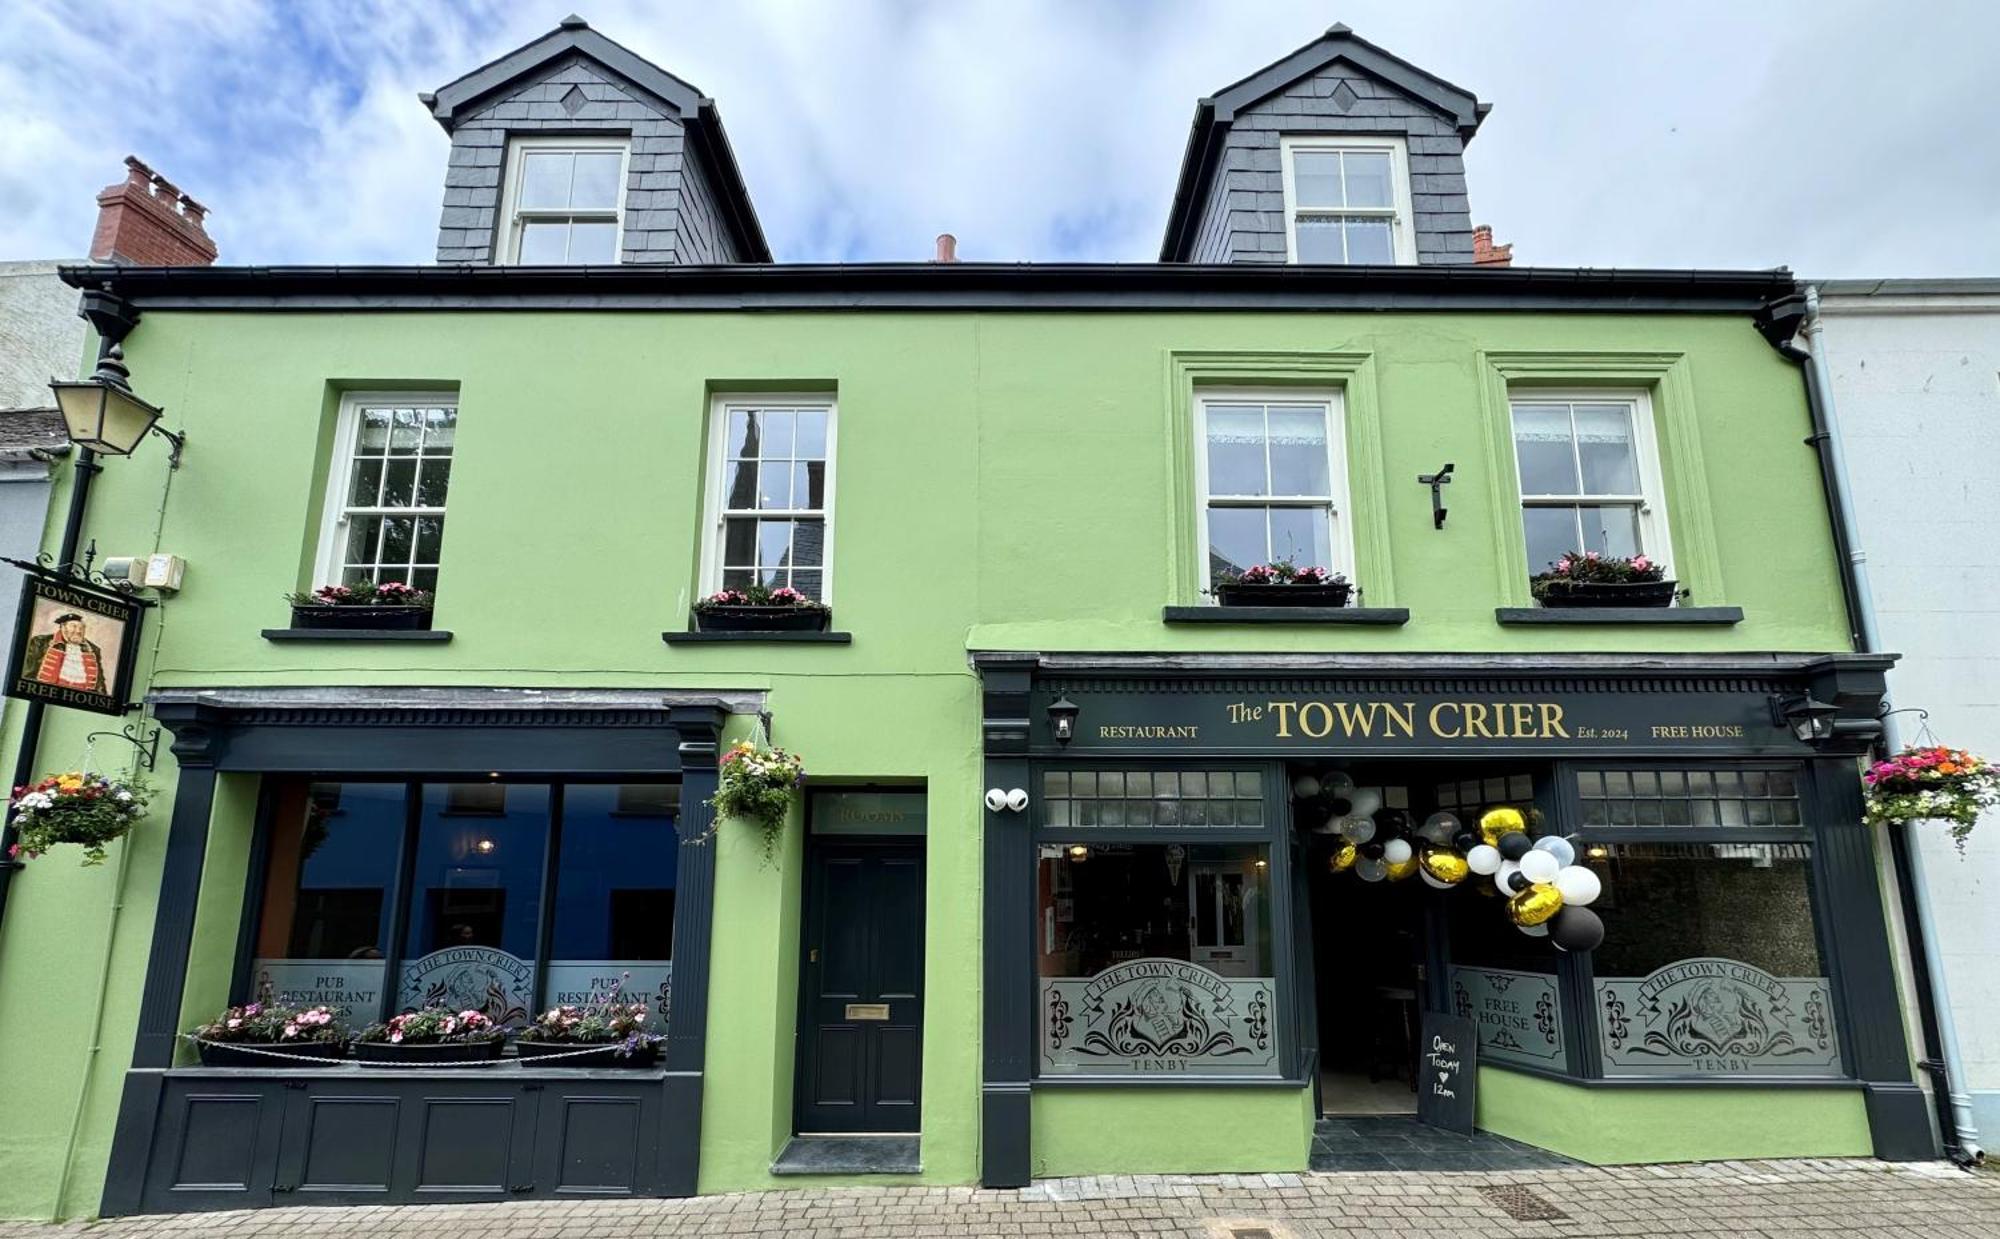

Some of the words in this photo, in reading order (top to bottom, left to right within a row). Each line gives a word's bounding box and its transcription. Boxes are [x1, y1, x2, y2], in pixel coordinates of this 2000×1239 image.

[34, 582, 84, 606] TOWN
[87, 599, 129, 620] CRIER
[16, 680, 59, 698] FREE
[63, 690, 115, 708] HOUSE
[1100, 726, 1198, 738] RESTAURANT
[1227, 702, 1262, 723] The
[1268, 701, 1416, 737] TOWN
[1429, 702, 1570, 738] CRIER
[1601, 728, 1629, 741] 2024
[1651, 726, 1688, 738] FREE
[1692, 726, 1744, 738] HOUSE
[416, 957, 444, 974] THE
[446, 950, 485, 961] TOWN
[488, 952, 523, 975] CRIER
[316, 976, 344, 988] PUB
[1094, 970, 1124, 994] THE
[1126, 964, 1174, 978] TOWN
[1177, 967, 1222, 994] CRIER
[1646, 969, 1677, 995] THE
[1677, 962, 1727, 978] TOWN
[1731, 966, 1777, 994] CRIER
[281, 990, 376, 1003] RESTAURANT
[1484, 998, 1521, 1014] FREE
[1479, 1011, 1530, 1030] HOUSE
[1131, 1059, 1188, 1071] TENBY
[1693, 1059, 1751, 1071] TENBY
